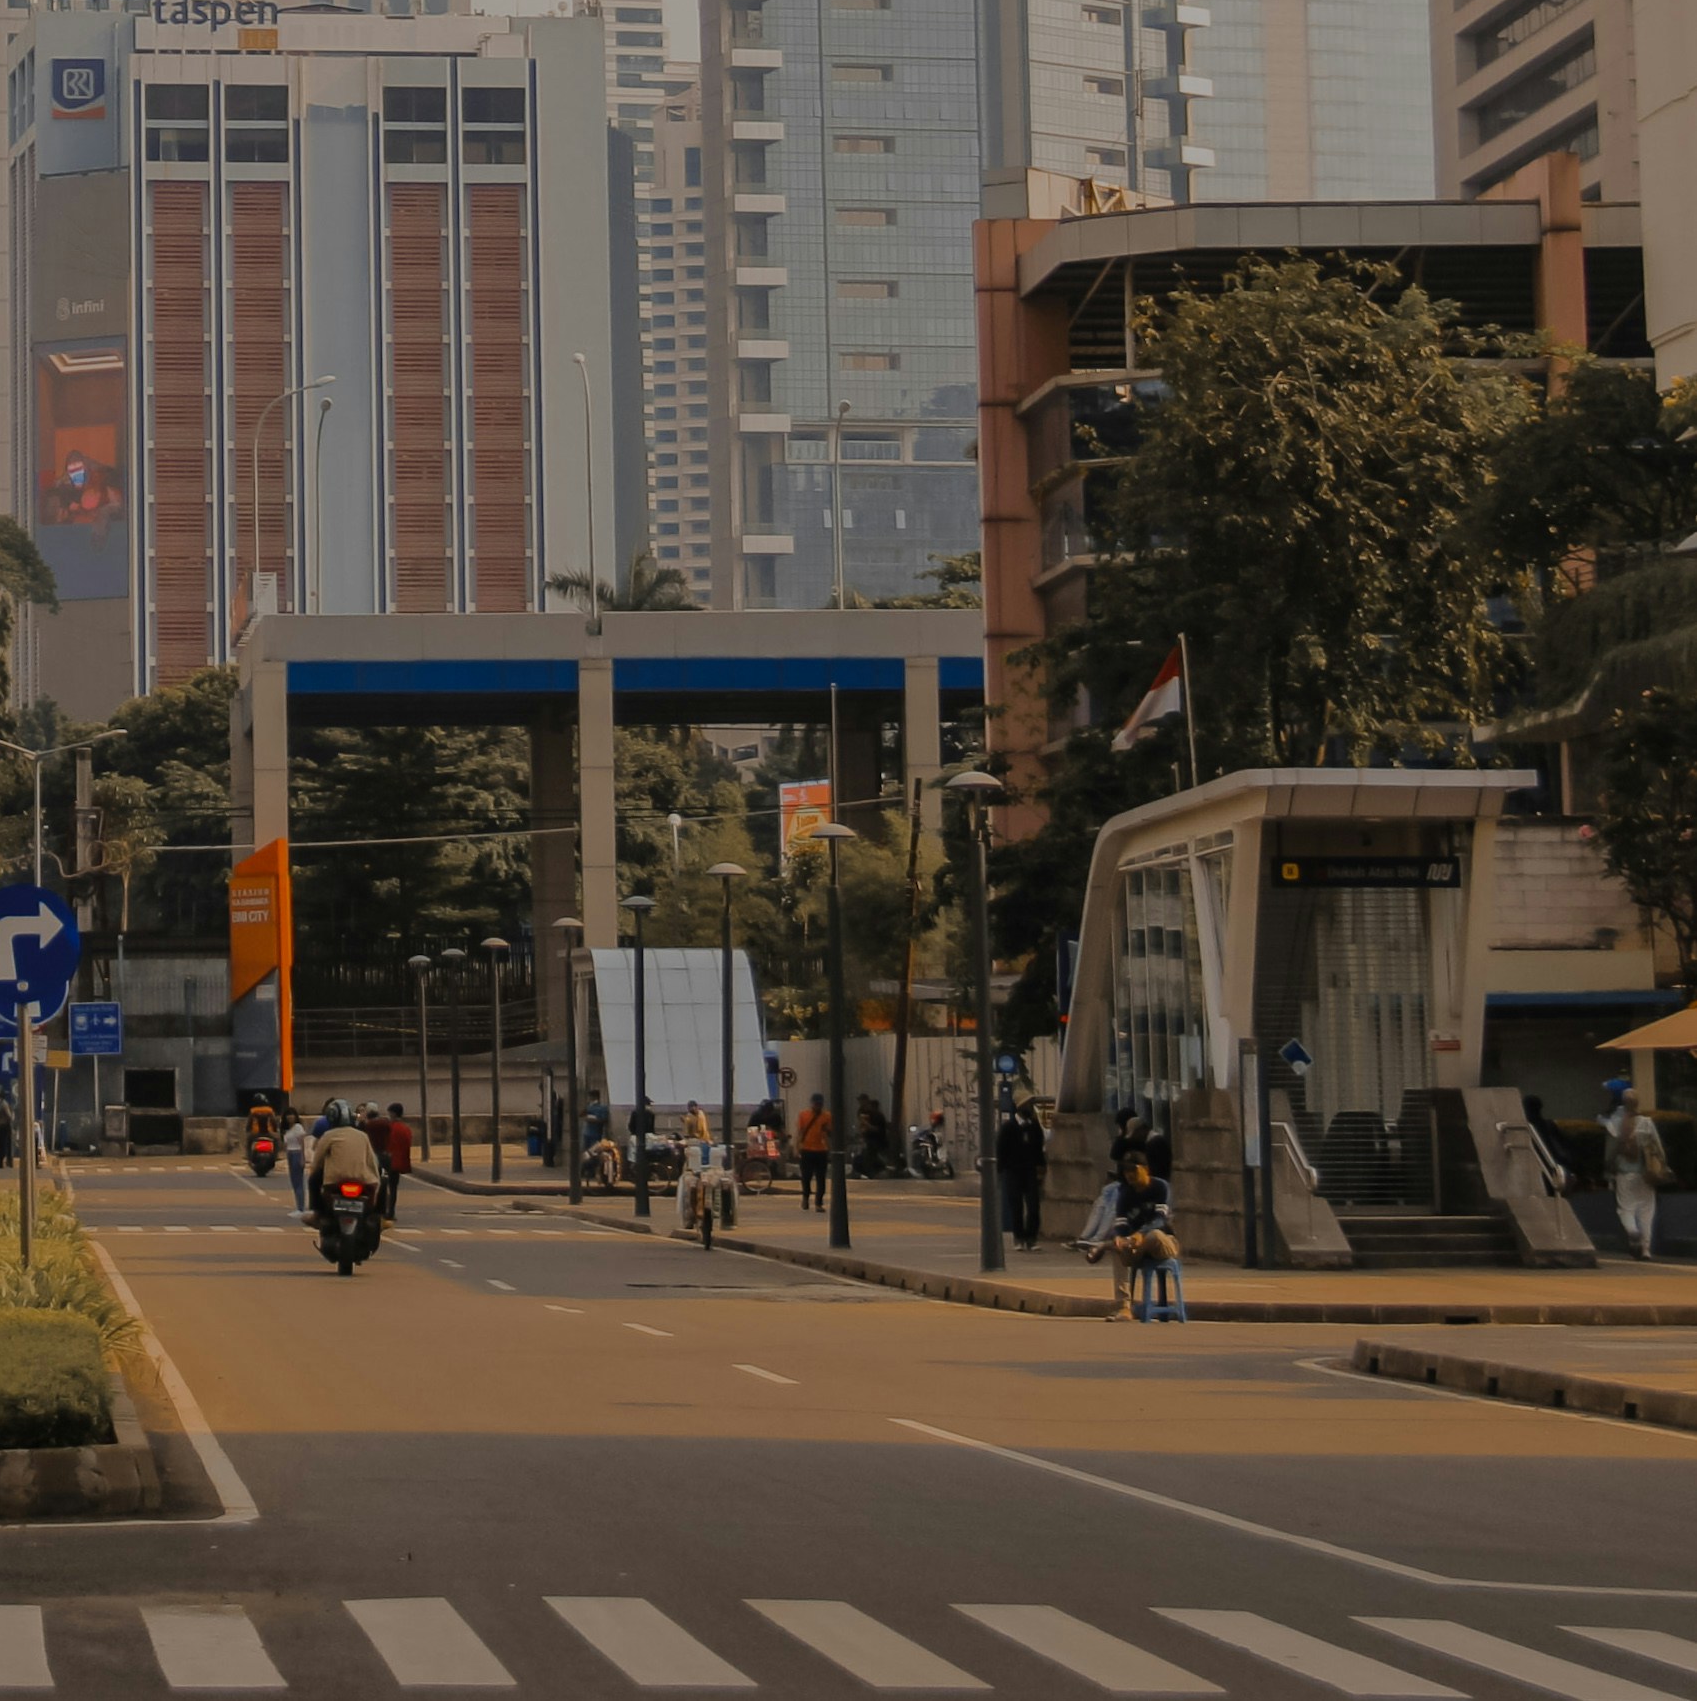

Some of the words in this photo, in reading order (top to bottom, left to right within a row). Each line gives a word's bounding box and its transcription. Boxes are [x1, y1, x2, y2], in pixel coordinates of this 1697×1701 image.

[153, 0, 277, 32] taspen
[71, 299, 104, 315] infini
[249, 909, 269, 922] CITY
